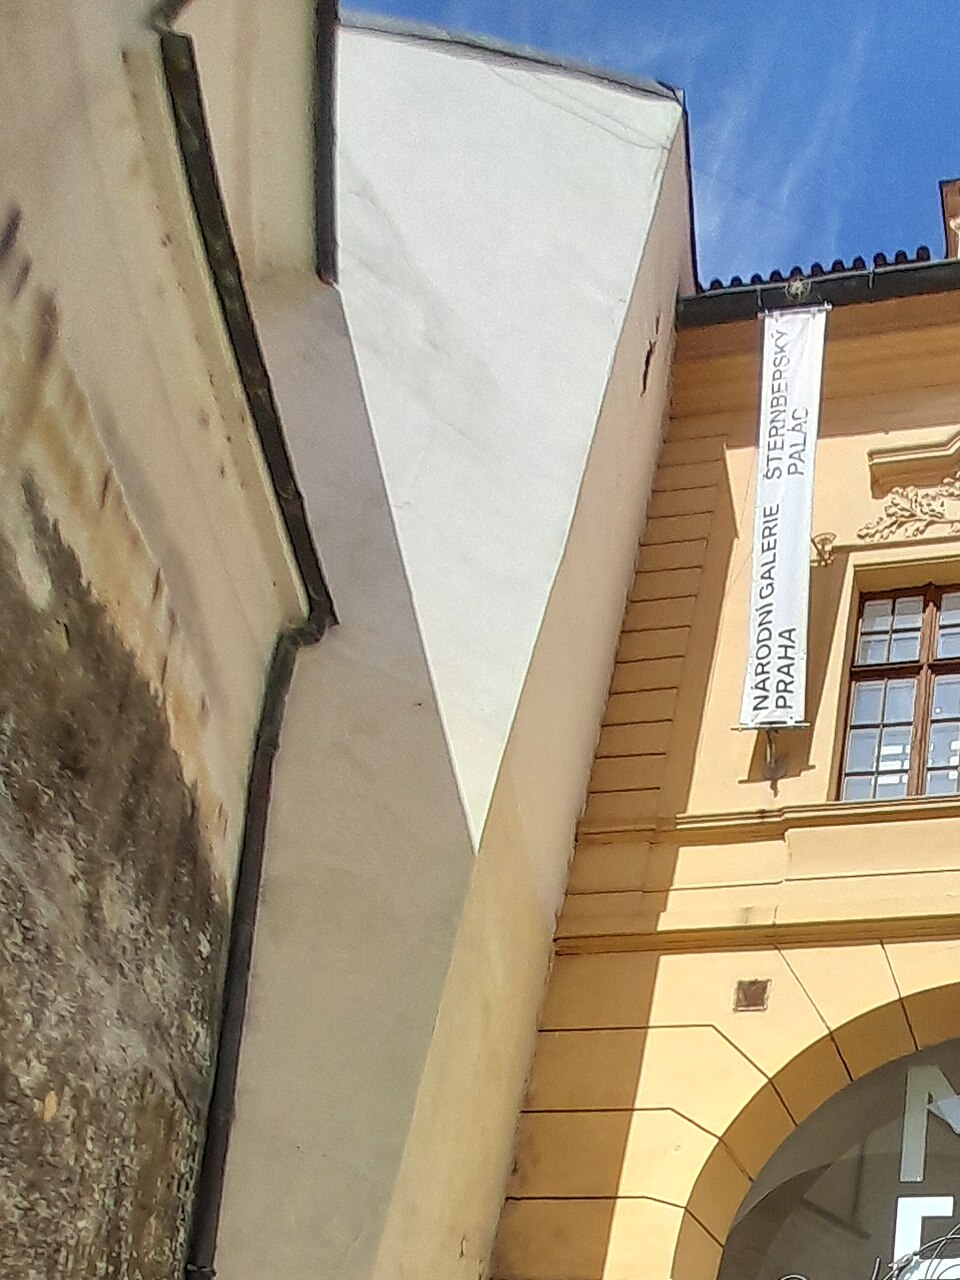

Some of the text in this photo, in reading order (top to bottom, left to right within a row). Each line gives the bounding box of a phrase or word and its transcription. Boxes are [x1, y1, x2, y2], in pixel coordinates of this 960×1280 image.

[787, 407, 809, 476] PALÁC
[751, 504, 779, 711] NÁRODNÍ GALERIE
[775, 627, 797, 709] PRAHA
